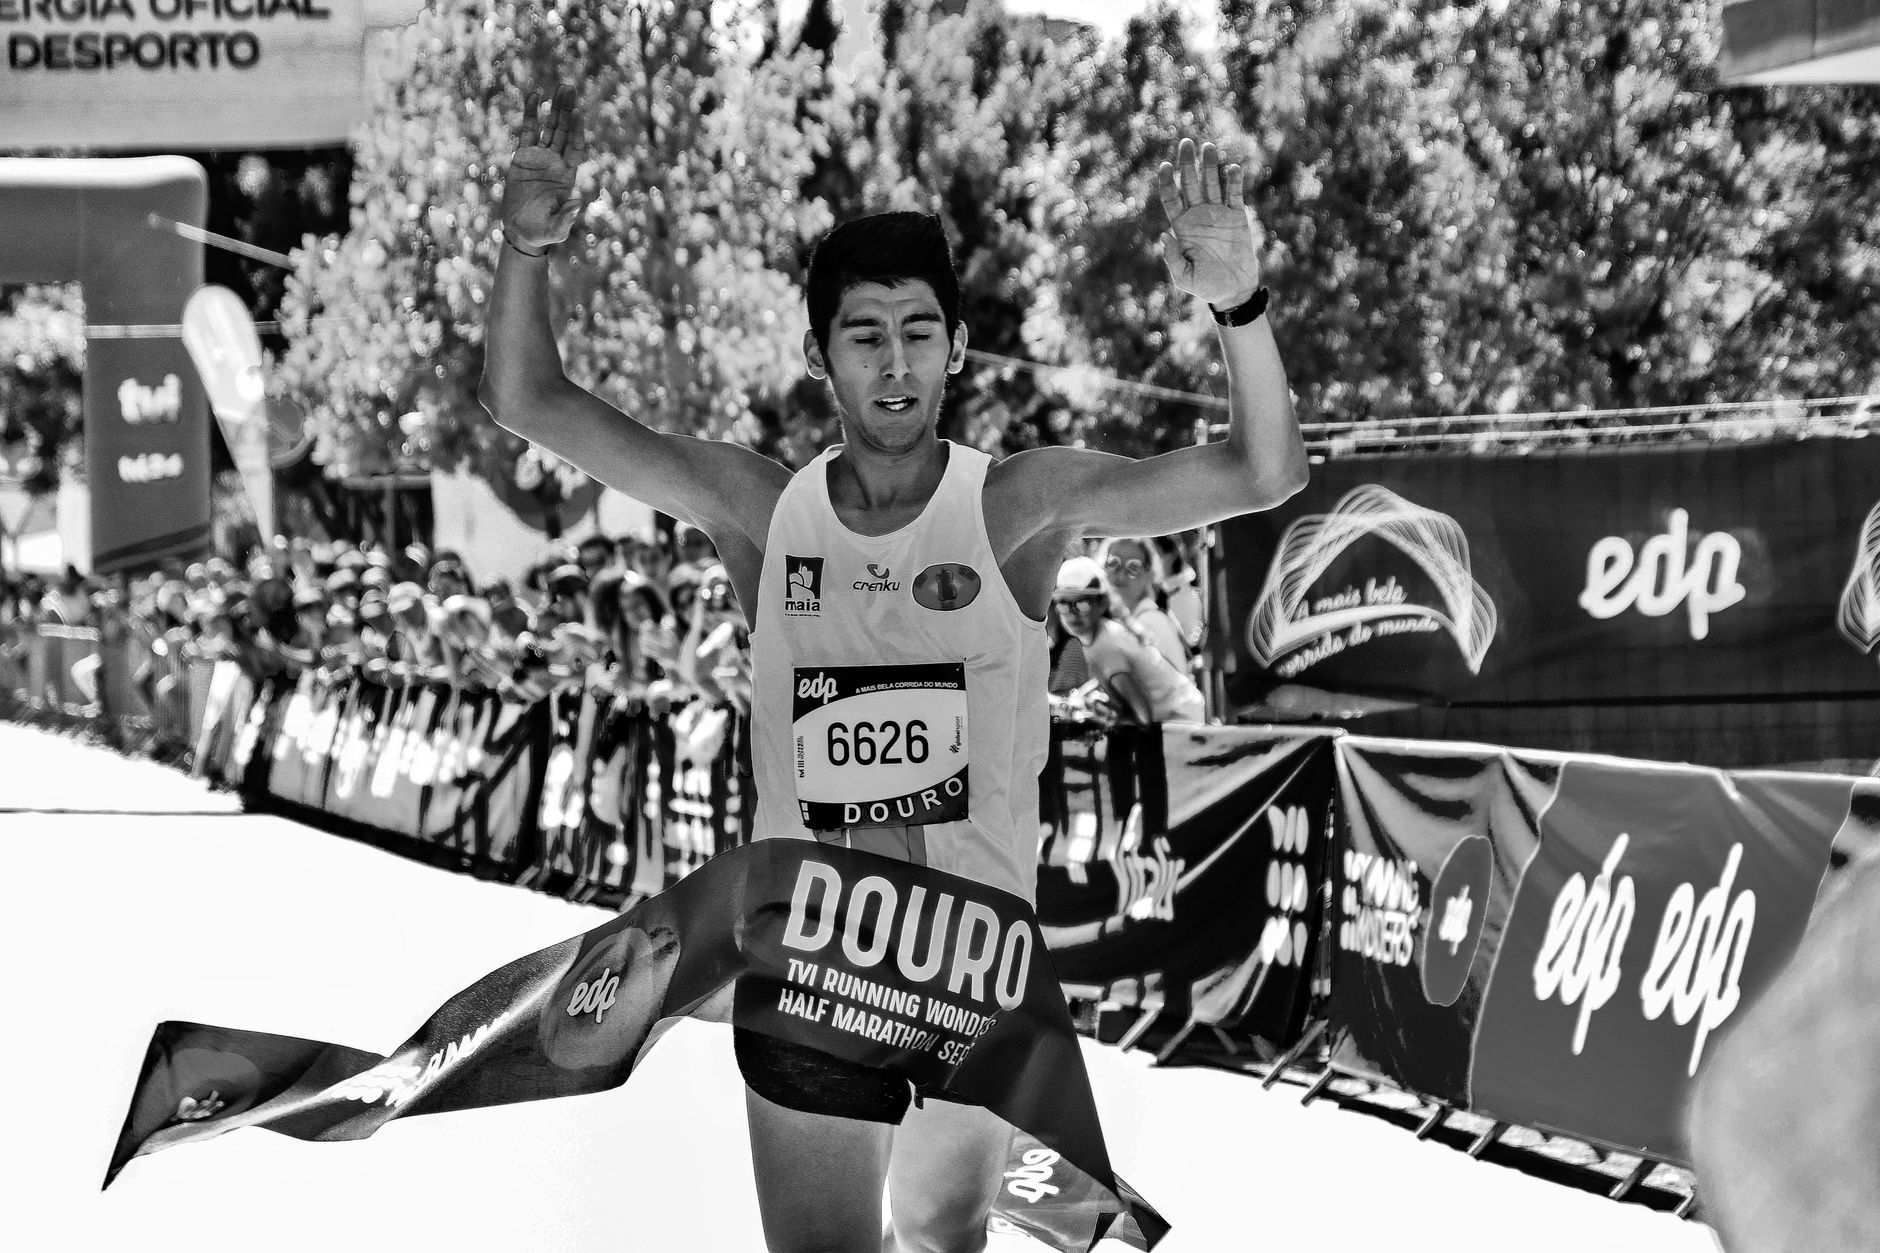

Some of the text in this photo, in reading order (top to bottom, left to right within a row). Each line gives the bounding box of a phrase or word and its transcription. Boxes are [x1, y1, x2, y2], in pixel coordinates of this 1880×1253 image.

[8, 31, 260, 70] DESPORTO
[1578, 507, 1746, 640] edp
[784, 598, 821, 612] maia
[797, 672, 838, 705] edp
[935, 681, 958, 689] MUNDO
[828, 720, 929, 766] 6626
[844, 777, 963, 823] DOURO
[782, 860, 1032, 1011] DOURO
[1532, 833, 1636, 1056] edp
[1640, 842, 1756, 1078] edp
[566, 968, 620, 1024] edp
[787, 958, 818, 986] TVI
[822, 968, 920, 1018] RUNNING
[777, 988, 829, 1023] HALF
[832, 1003, 940, 1052] MARATHON
